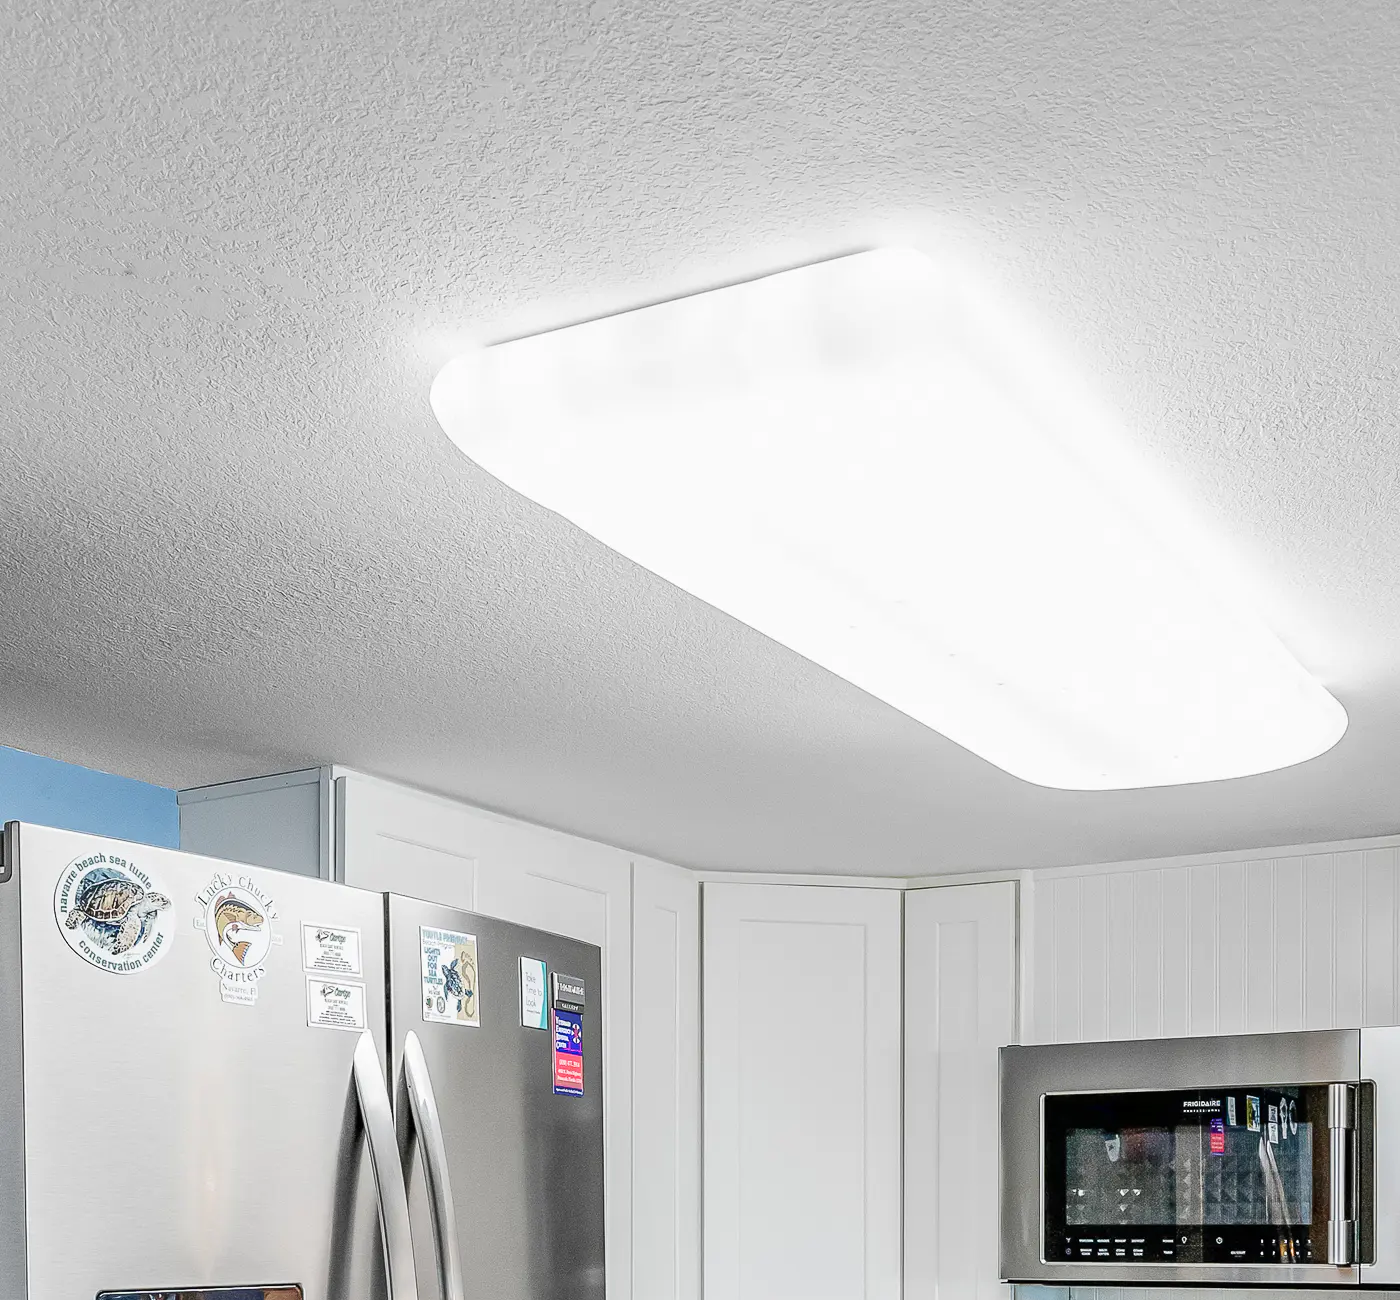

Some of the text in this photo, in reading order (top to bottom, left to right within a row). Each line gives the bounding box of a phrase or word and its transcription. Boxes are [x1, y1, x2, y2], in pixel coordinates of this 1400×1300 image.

[60, 852, 152, 913] navarre beach sea turtle
[197, 873, 279, 920] Lucky Chucky
[79, 932, 164, 971] conservation center
[427, 954, 438, 963] OUT
[212, 958, 265, 983] Charters
[423, 976, 443, 986] TURTLES
